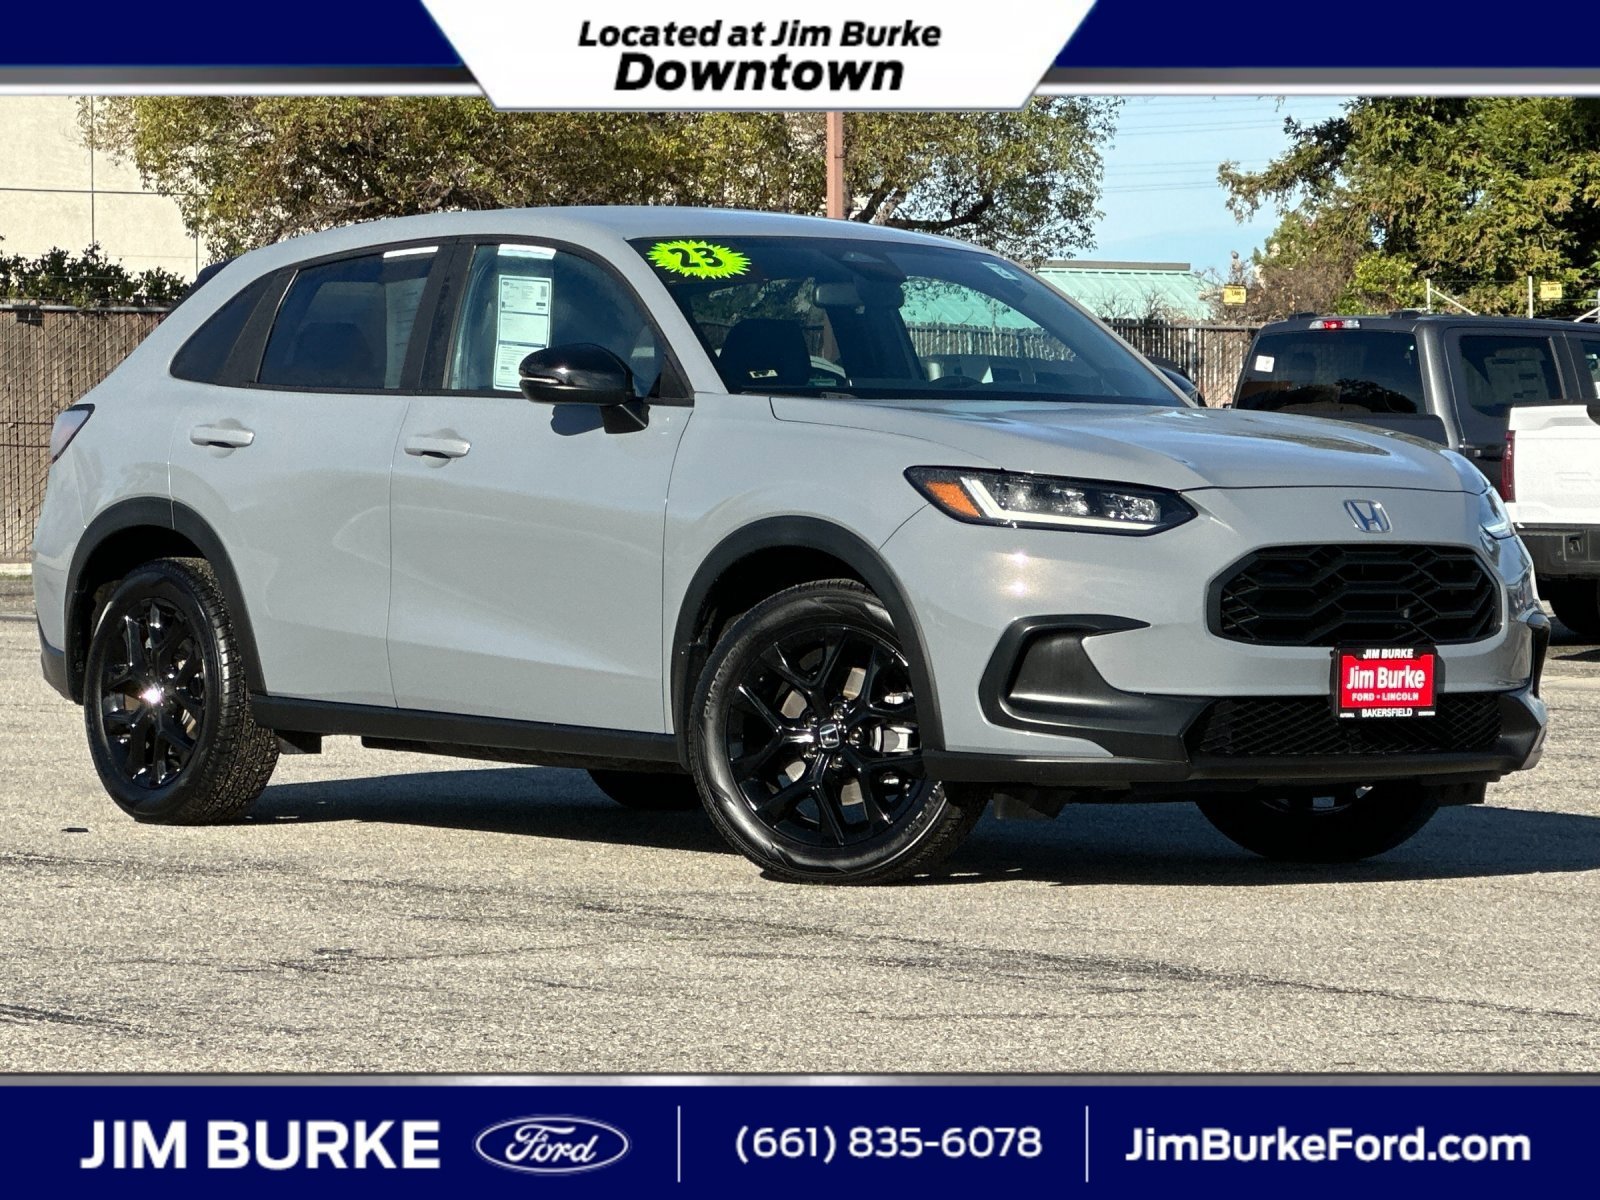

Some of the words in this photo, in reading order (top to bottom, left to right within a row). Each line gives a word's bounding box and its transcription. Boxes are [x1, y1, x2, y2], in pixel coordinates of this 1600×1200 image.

[668, 247, 724, 268] 23
[1363, 649, 1380, 660] JIM
[1381, 648, 1414, 659] BURKE
[1346, 665, 1375, 690] Jim
[1377, 665, 1426, 689] Burke
[1352, 692, 1375, 702] FORD
[1382, 692, 1419, 701] LINCOLN
[1362, 708, 1413, 718] BAKERSFIELD
